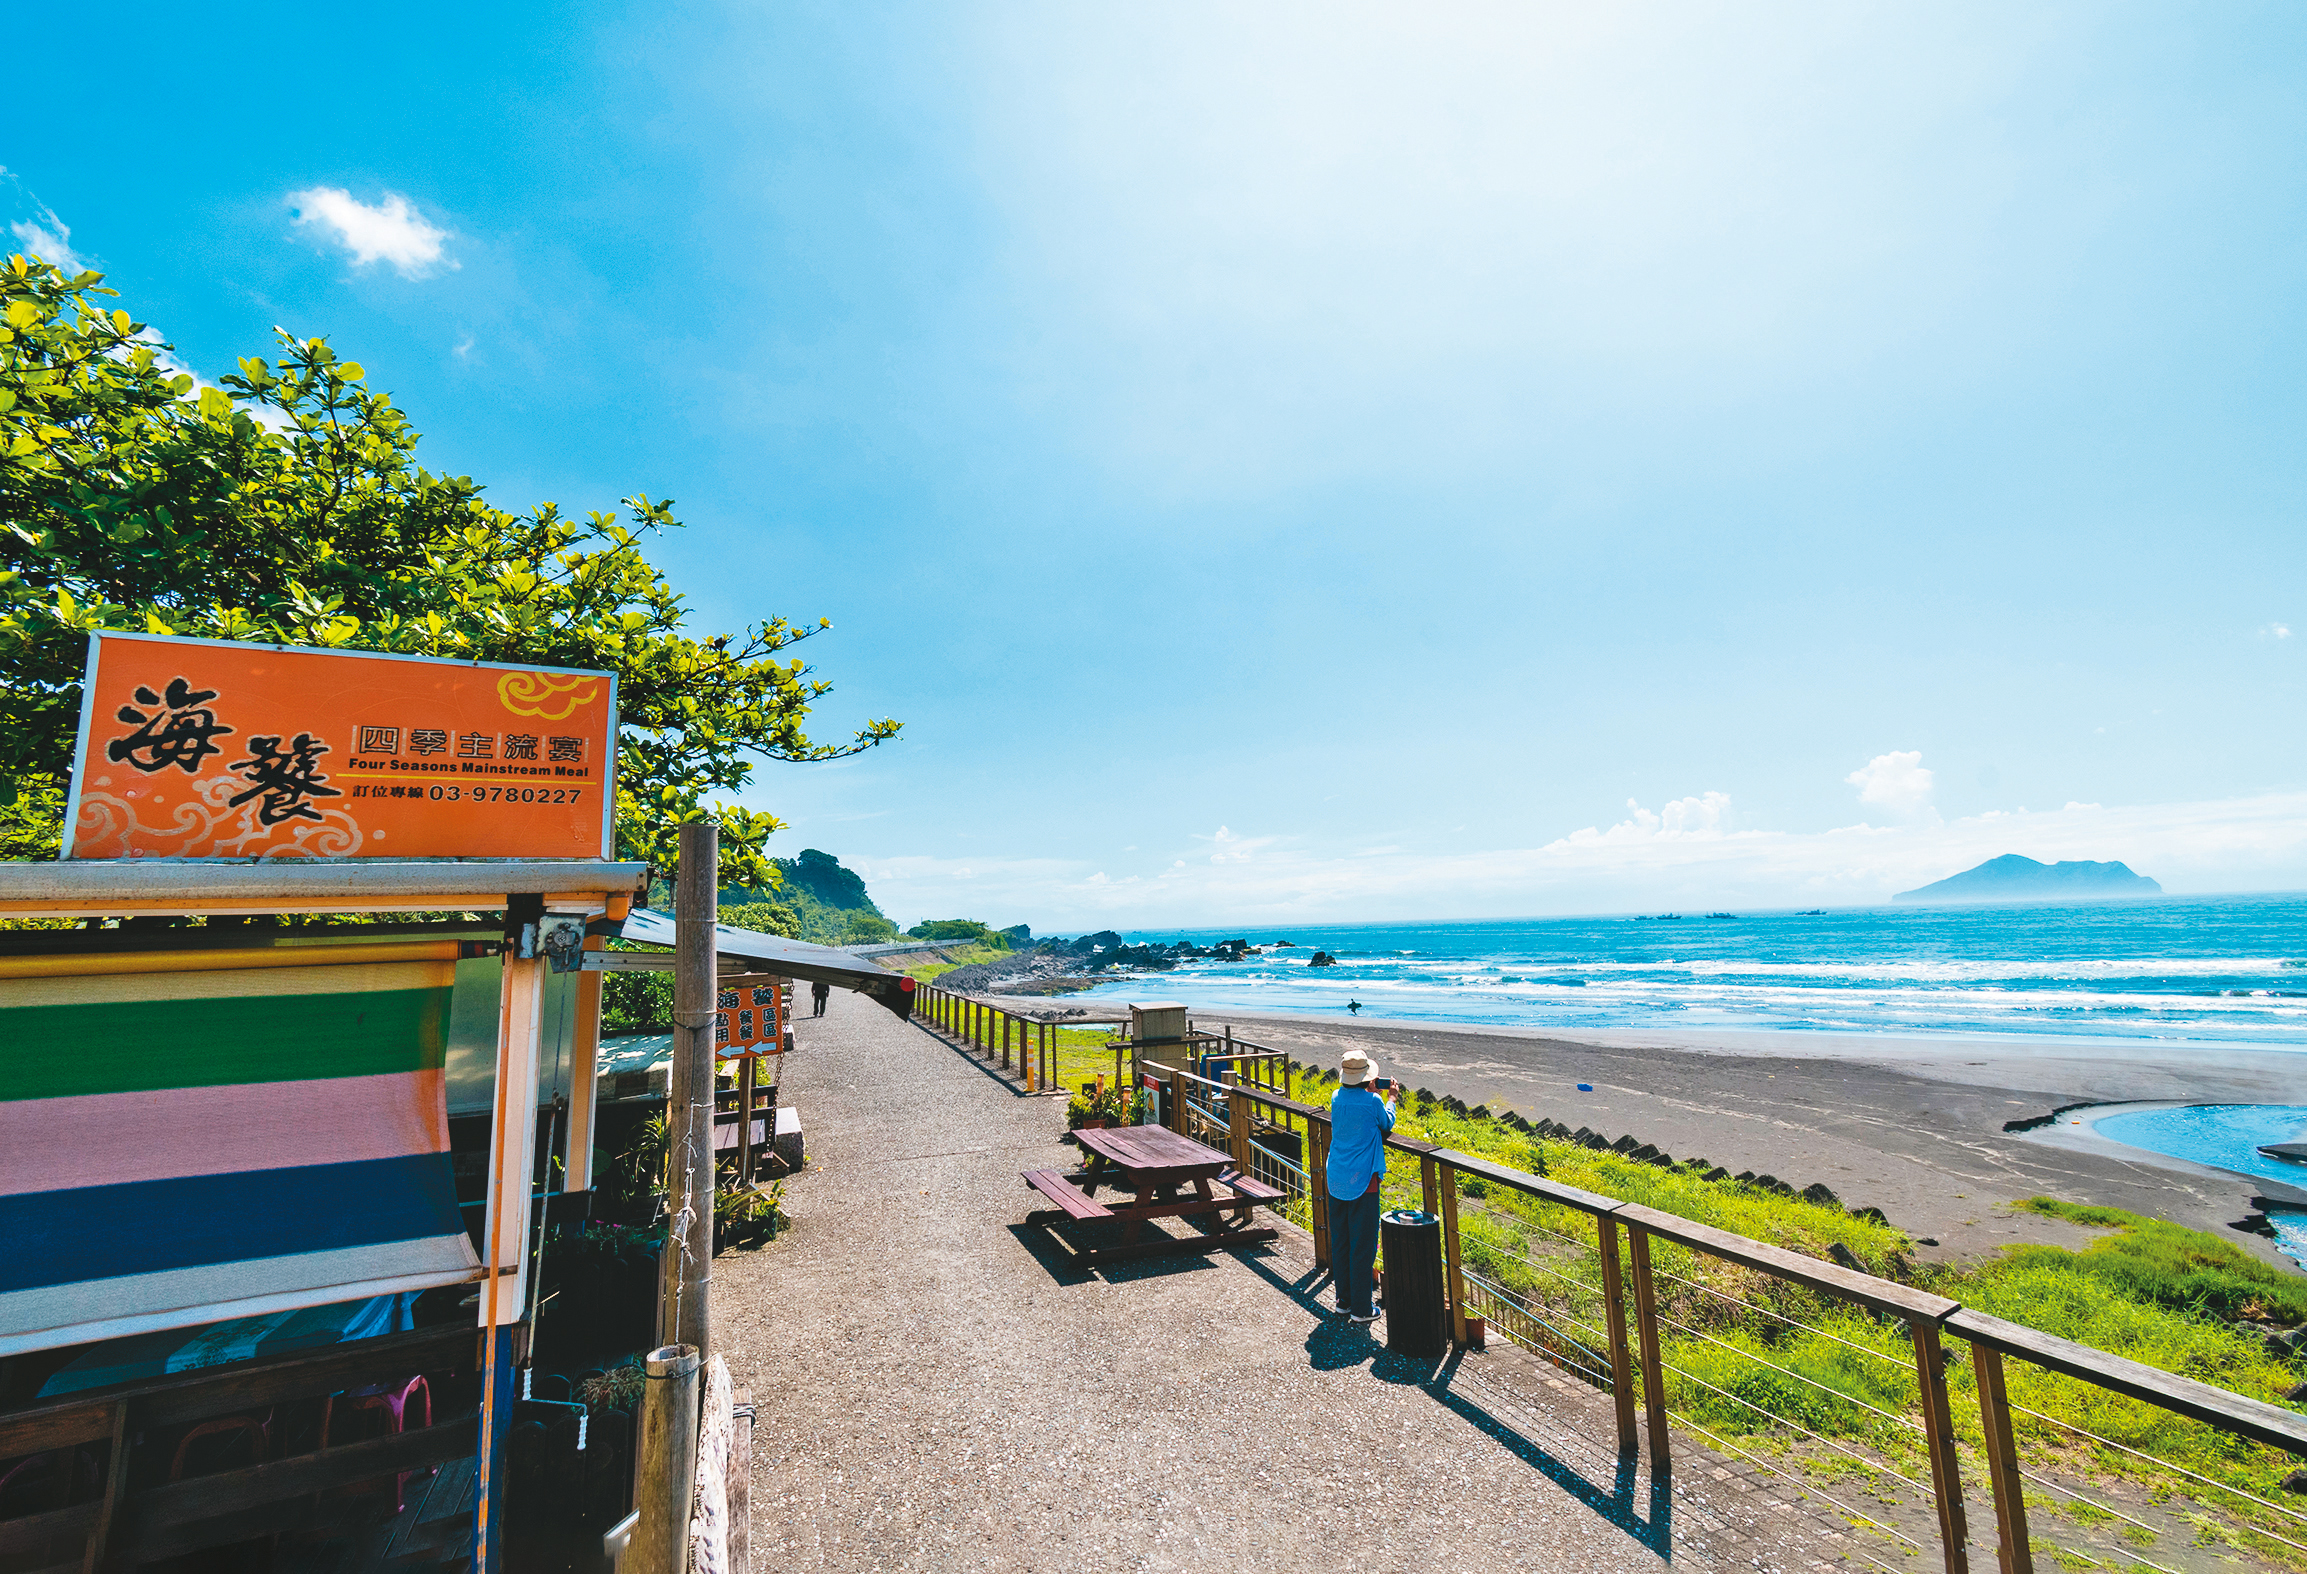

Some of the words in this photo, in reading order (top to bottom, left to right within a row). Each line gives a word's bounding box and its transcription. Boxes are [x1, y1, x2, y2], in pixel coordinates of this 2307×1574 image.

[359, 725, 583, 763] 四季主流宴
[349, 758, 386, 770] Four
[390, 759, 458, 773] Seasons
[462, 762, 551, 776] Mainstream
[555, 766, 589, 777] Meal
[352, 785, 424, 798] 訂位專線
[429, 785, 582, 804] 03-9780227
